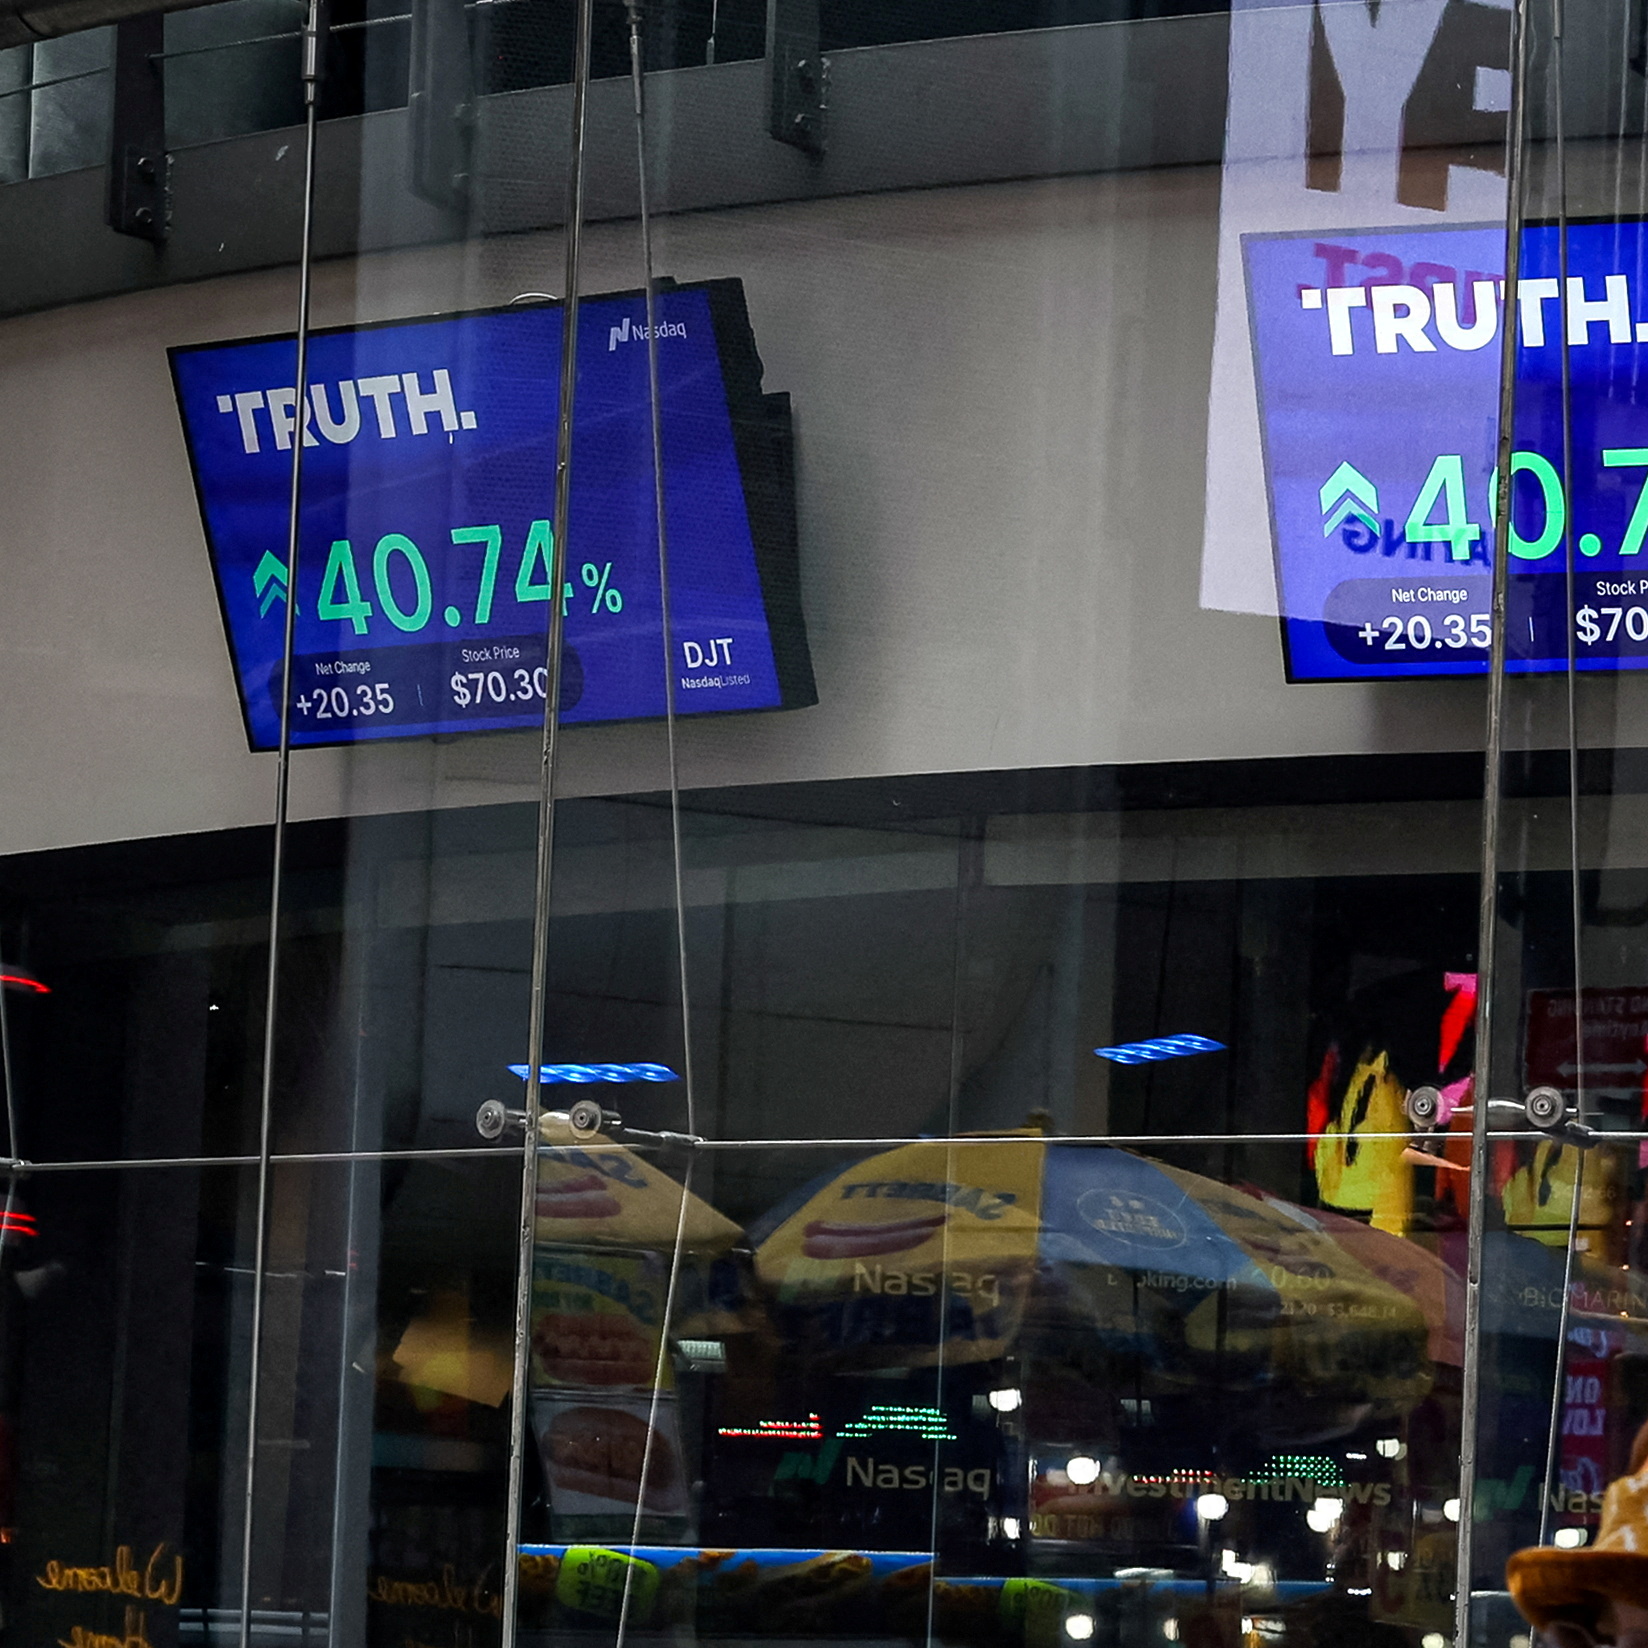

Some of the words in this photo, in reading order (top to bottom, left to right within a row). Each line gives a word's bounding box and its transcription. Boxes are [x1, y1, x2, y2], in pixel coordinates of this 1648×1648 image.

[633, 319, 687, 341] Nasdaq
[216, 368, 477, 454] TRUTH.
[1392, 588, 1418, 604] Net
[1421, 587, 1468, 606] Change
[1596, 581, 1637, 598] Stock
[1358, 613, 1492, 653] +20.35
[462, 648, 491, 663] Stock
[494, 645, 519, 661] Price
[683, 638, 734, 669] DJT
[315, 661, 335, 675] Net
[338, 659, 370, 677] Change
[297, 683, 394, 719] +20.35
[852, 1262, 999, 1307] Nasaq
